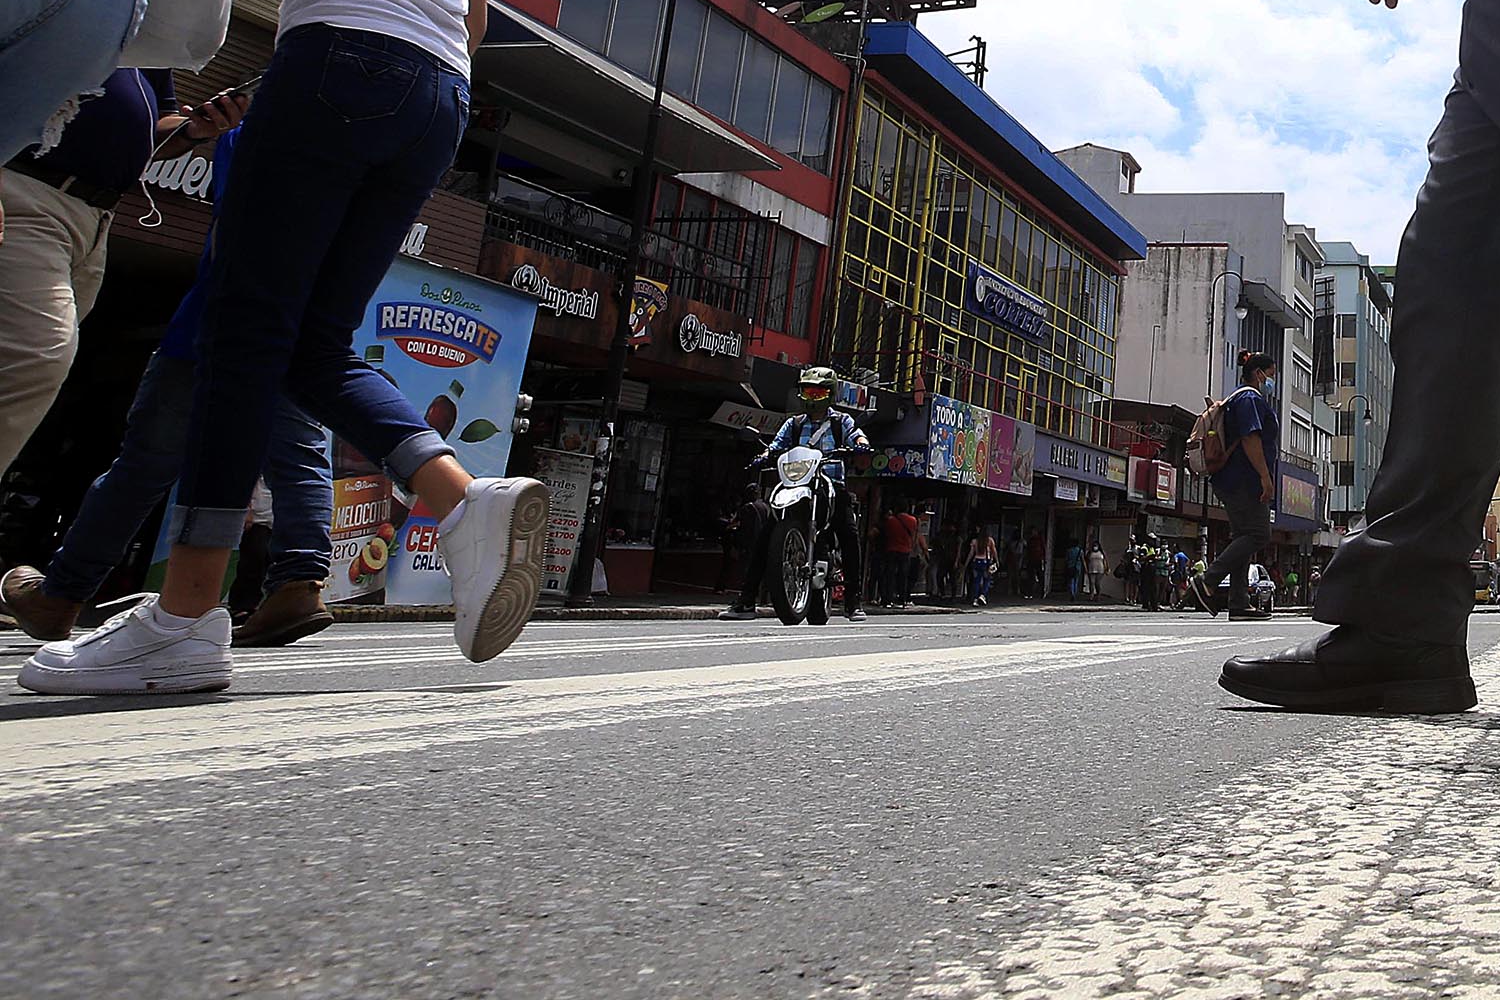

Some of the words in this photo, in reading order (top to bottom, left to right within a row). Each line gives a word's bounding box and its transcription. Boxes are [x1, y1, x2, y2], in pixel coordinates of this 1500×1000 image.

[541, 277, 598, 319] Imperial
[381, 305, 500, 355] REFRESCATE
[700, 323, 743, 358] Imperial
[407, 341, 425, 353] CON
[427, 343, 438, 355] LO
[439, 346, 466, 364] BUENO
[936, 405, 956, 427] TODO
[958, 412, 963, 429] A
